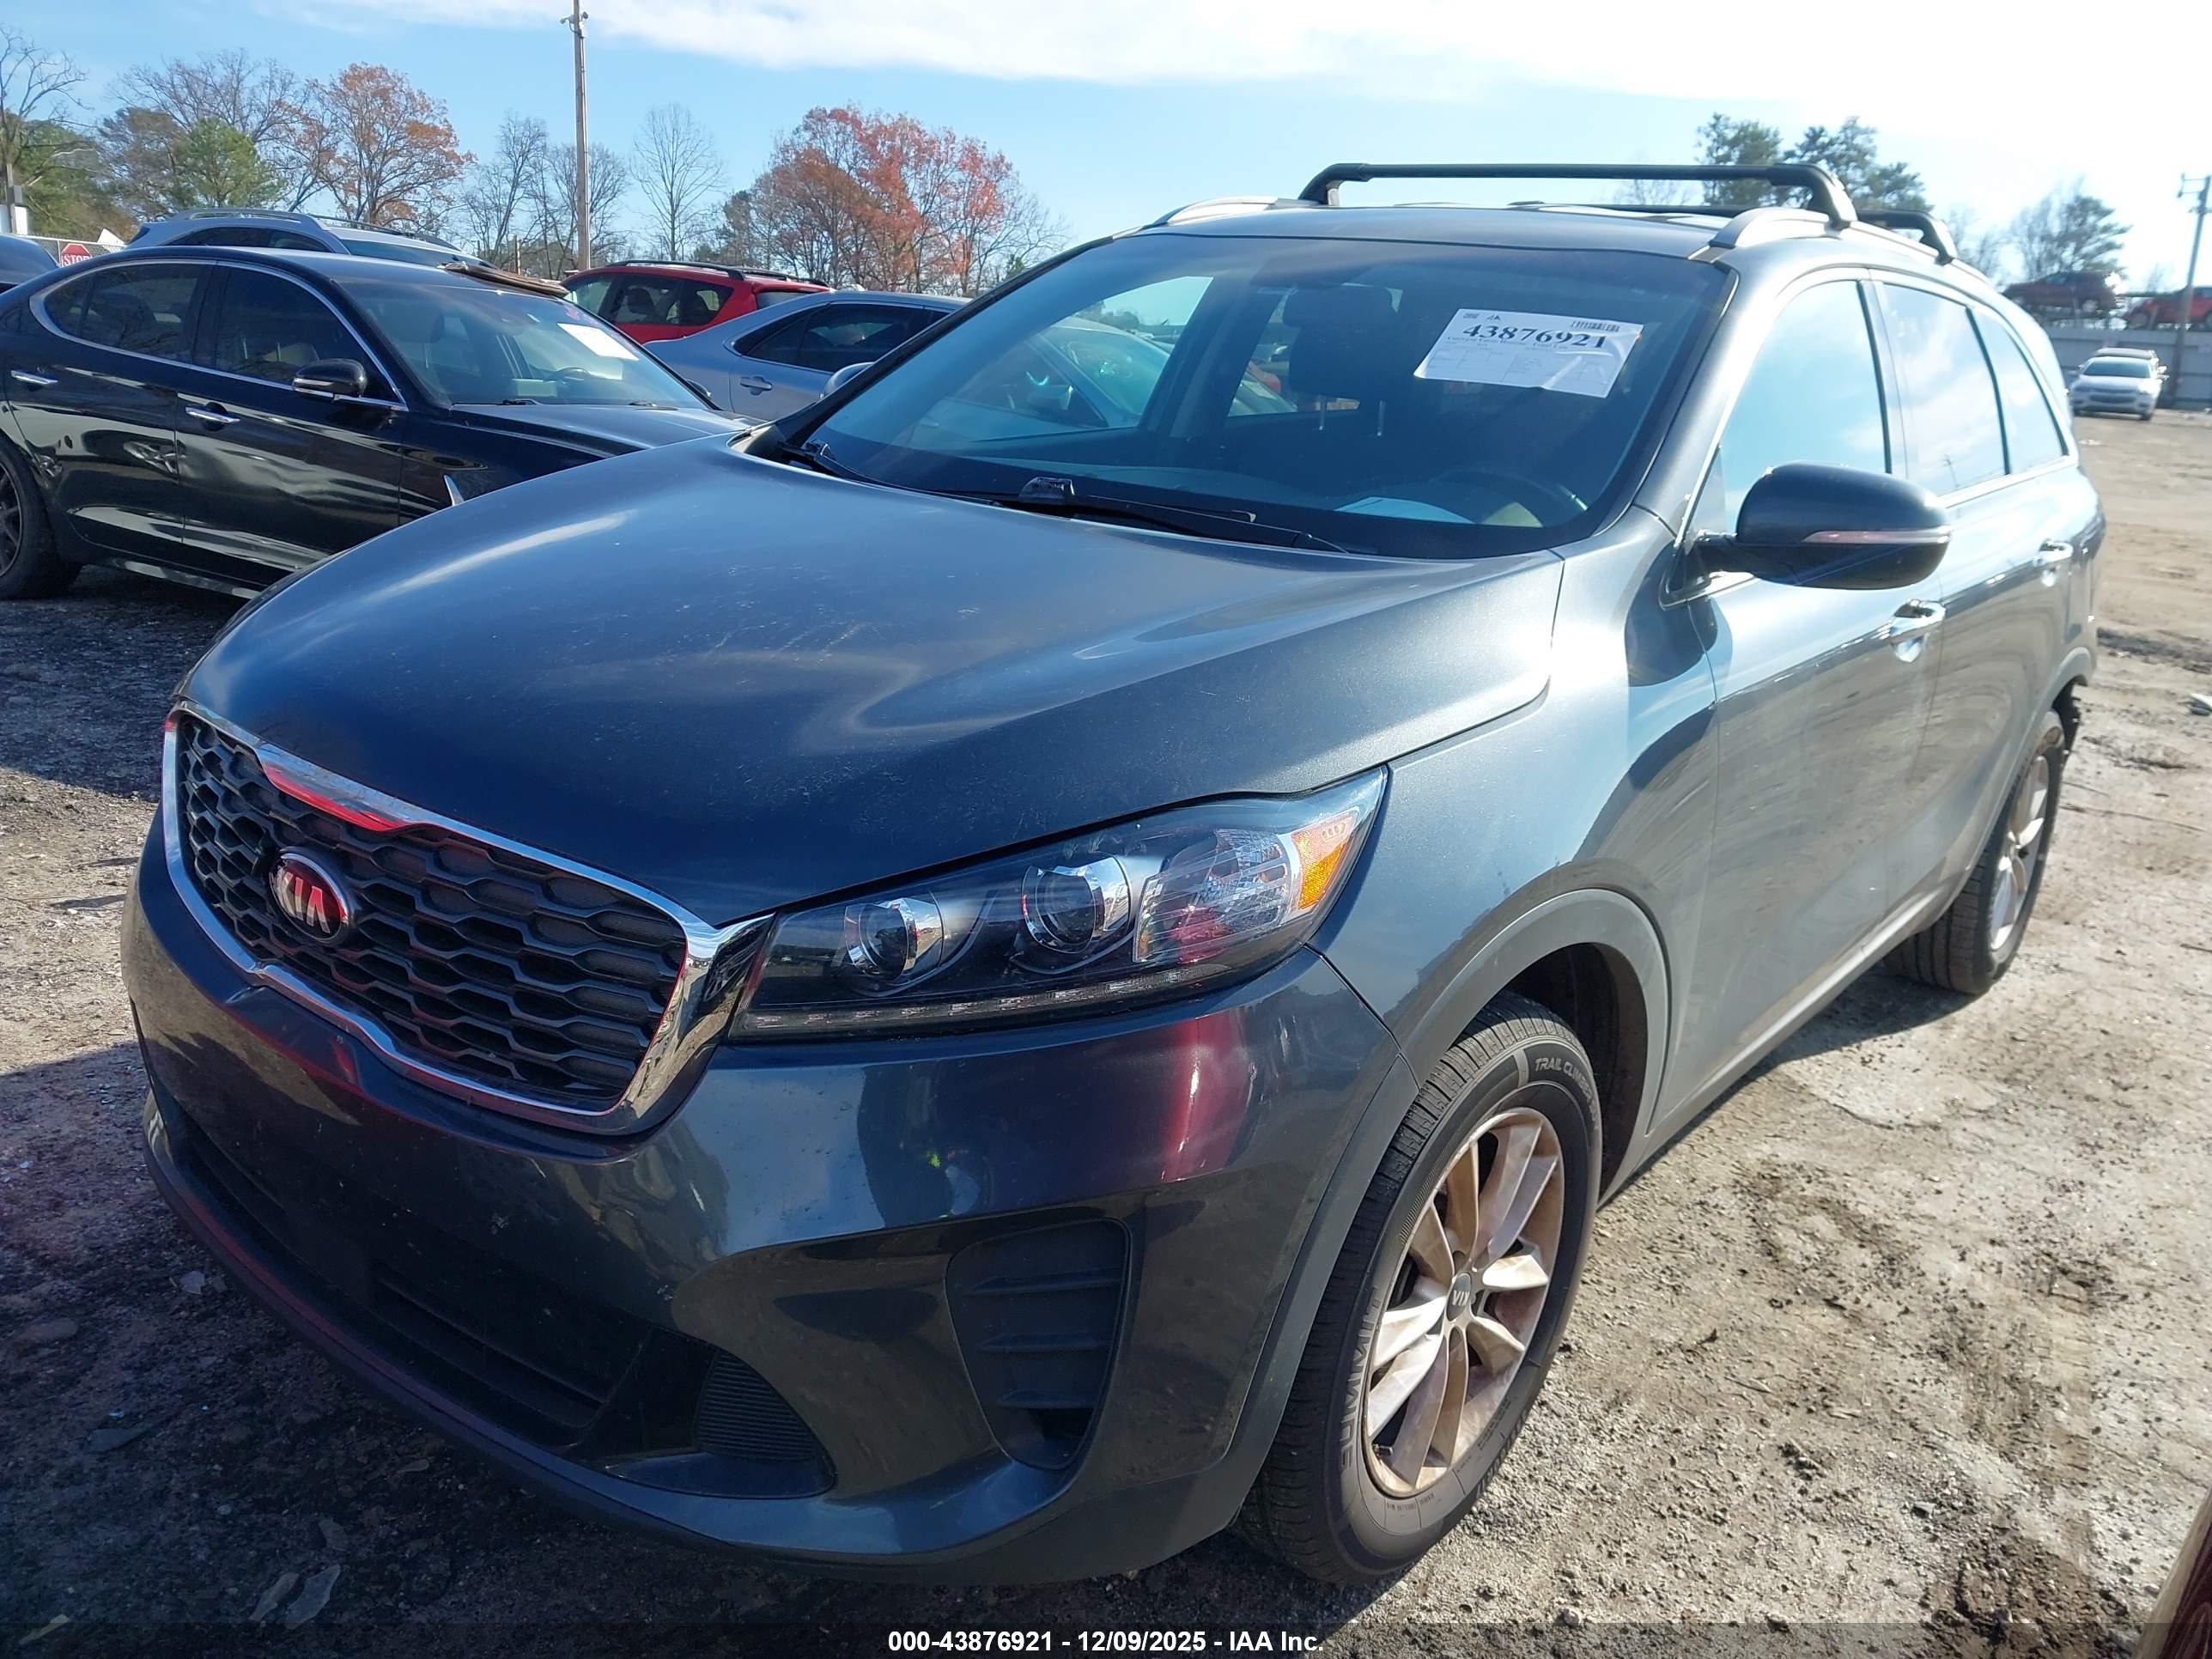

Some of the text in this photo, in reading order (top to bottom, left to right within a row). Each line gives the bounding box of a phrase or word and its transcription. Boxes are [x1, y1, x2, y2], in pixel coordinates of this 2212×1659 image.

[1462, 325, 1607, 348] 43876921
[276, 866, 331, 933] KIA
[1535, 1057, 1563, 1072] TRAIL
